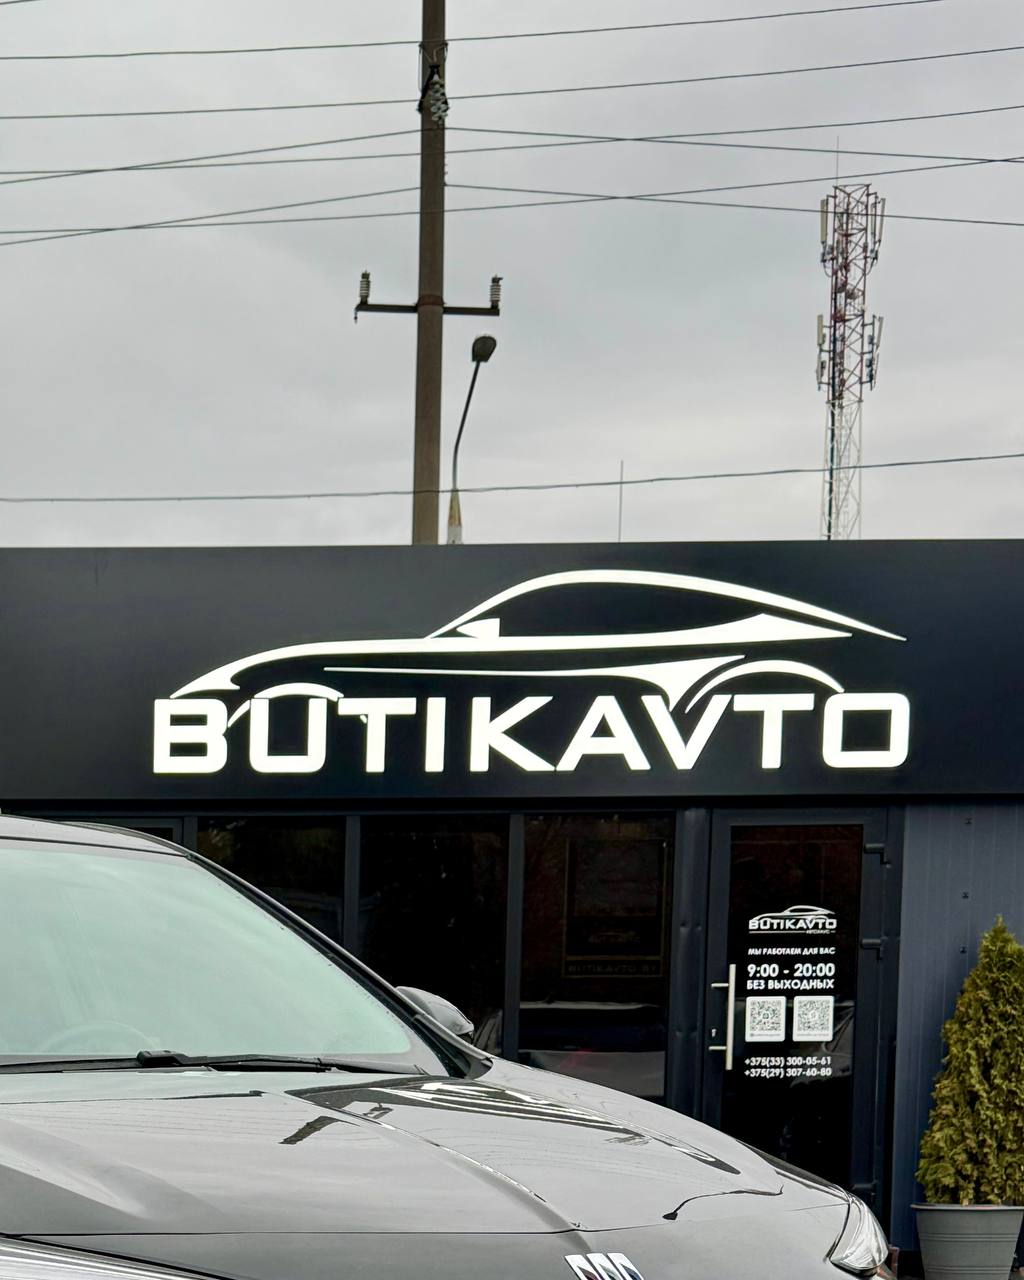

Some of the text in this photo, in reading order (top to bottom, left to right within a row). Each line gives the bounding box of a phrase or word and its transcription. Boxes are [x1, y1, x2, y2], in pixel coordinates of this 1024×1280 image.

[153, 692, 911, 775] BUTIKAVTO
[748, 918, 837, 930] BUTIKAVTO
[747, 964, 779, 977] 9:00
[794, 963, 835, 977] 20:00
[747, 979, 834, 990] БЕЗ ВЫХОДНЫХ
[744, 1056, 831, 1067] +375(33) 300-05-61
[744, 1068, 832, 1078] +375(29) 307-60-80
